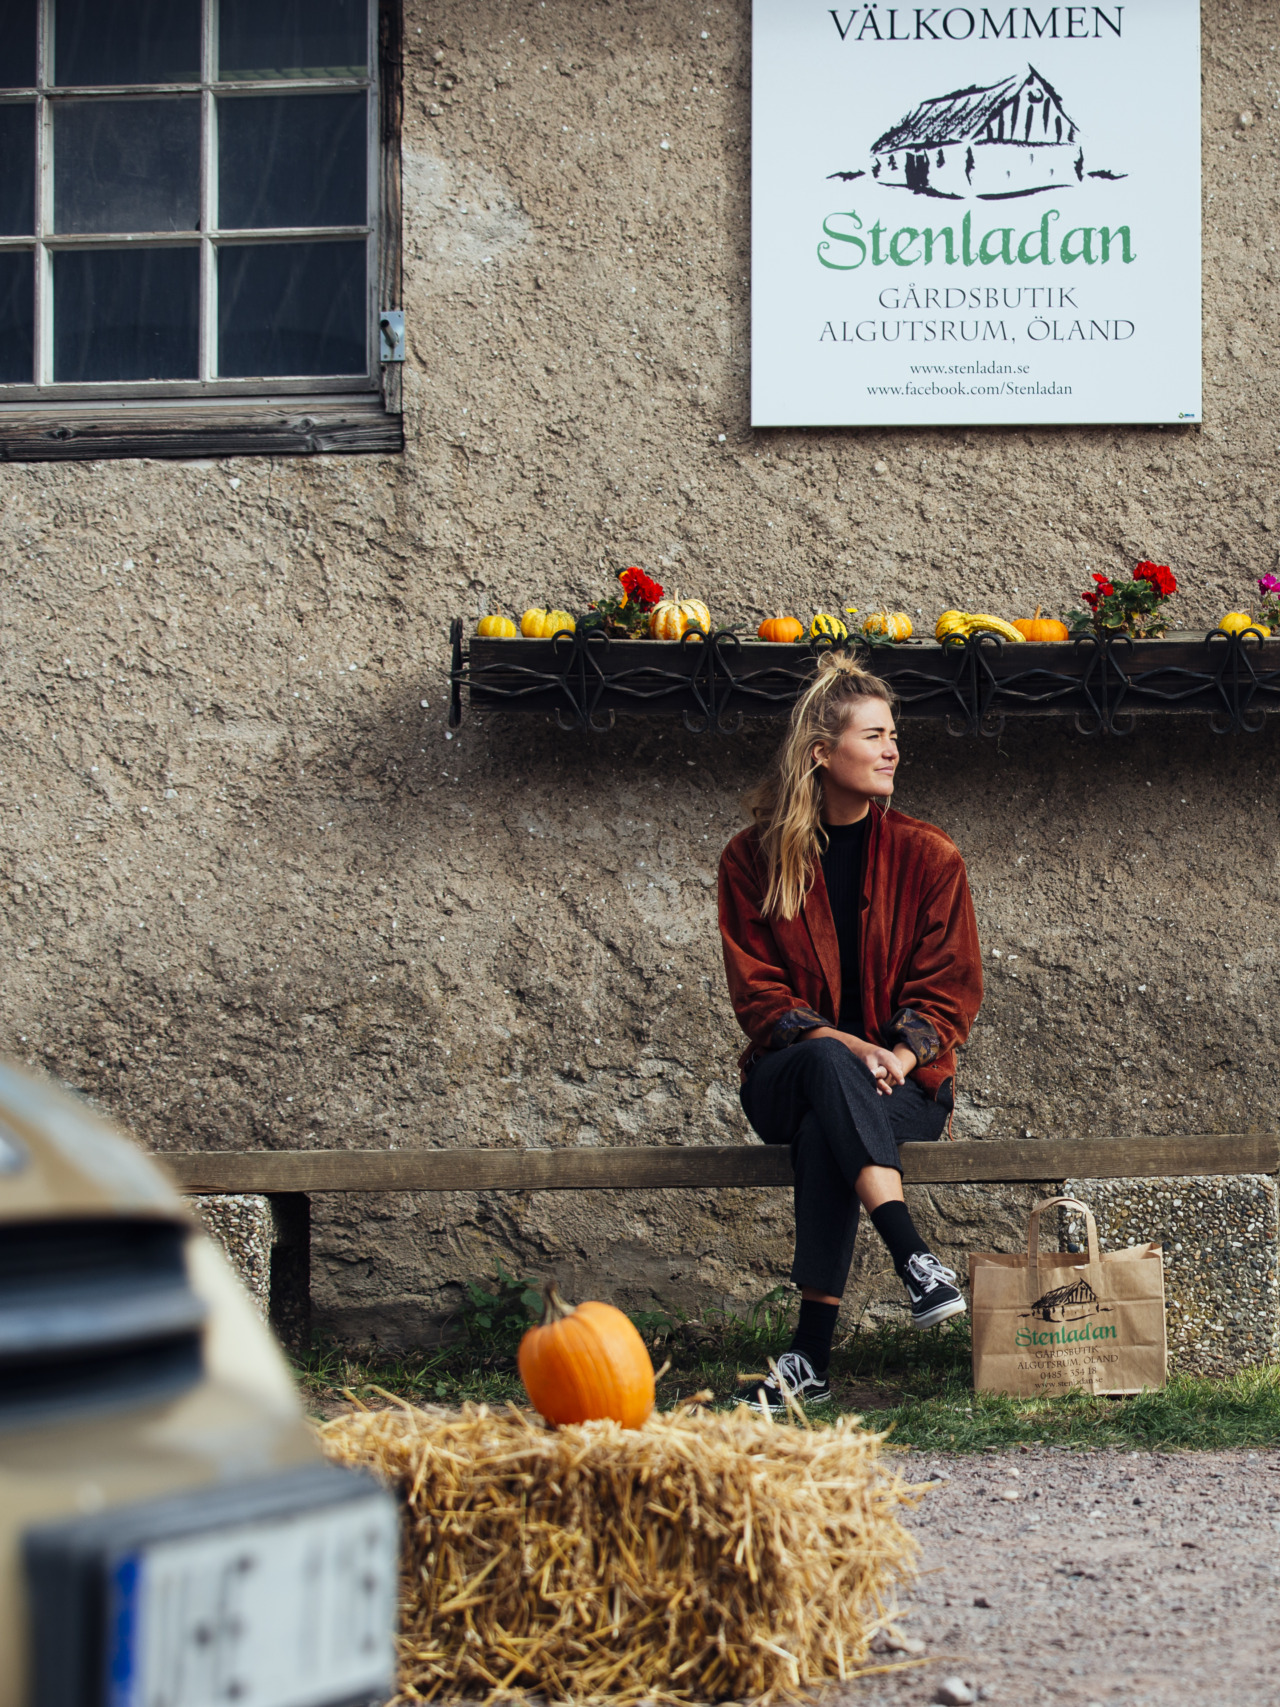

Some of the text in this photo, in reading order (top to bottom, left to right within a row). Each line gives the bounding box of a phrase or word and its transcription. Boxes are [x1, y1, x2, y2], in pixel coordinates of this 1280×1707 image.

[827, 3, 1126, 42] VÄLKOMMEN
[816, 208, 1137, 271] Stenladan
[878, 282, 1079, 310] GÅRDSBUTIK
[818, 315, 1136, 345] ALGUTSRUM, ÖLAND
[909, 359, 1030, 375] www.stenladan.se
[866, 380, 1073, 396] www.facebook.com/Stenladan
[1015, 1322, 1118, 1347] Stenladan
